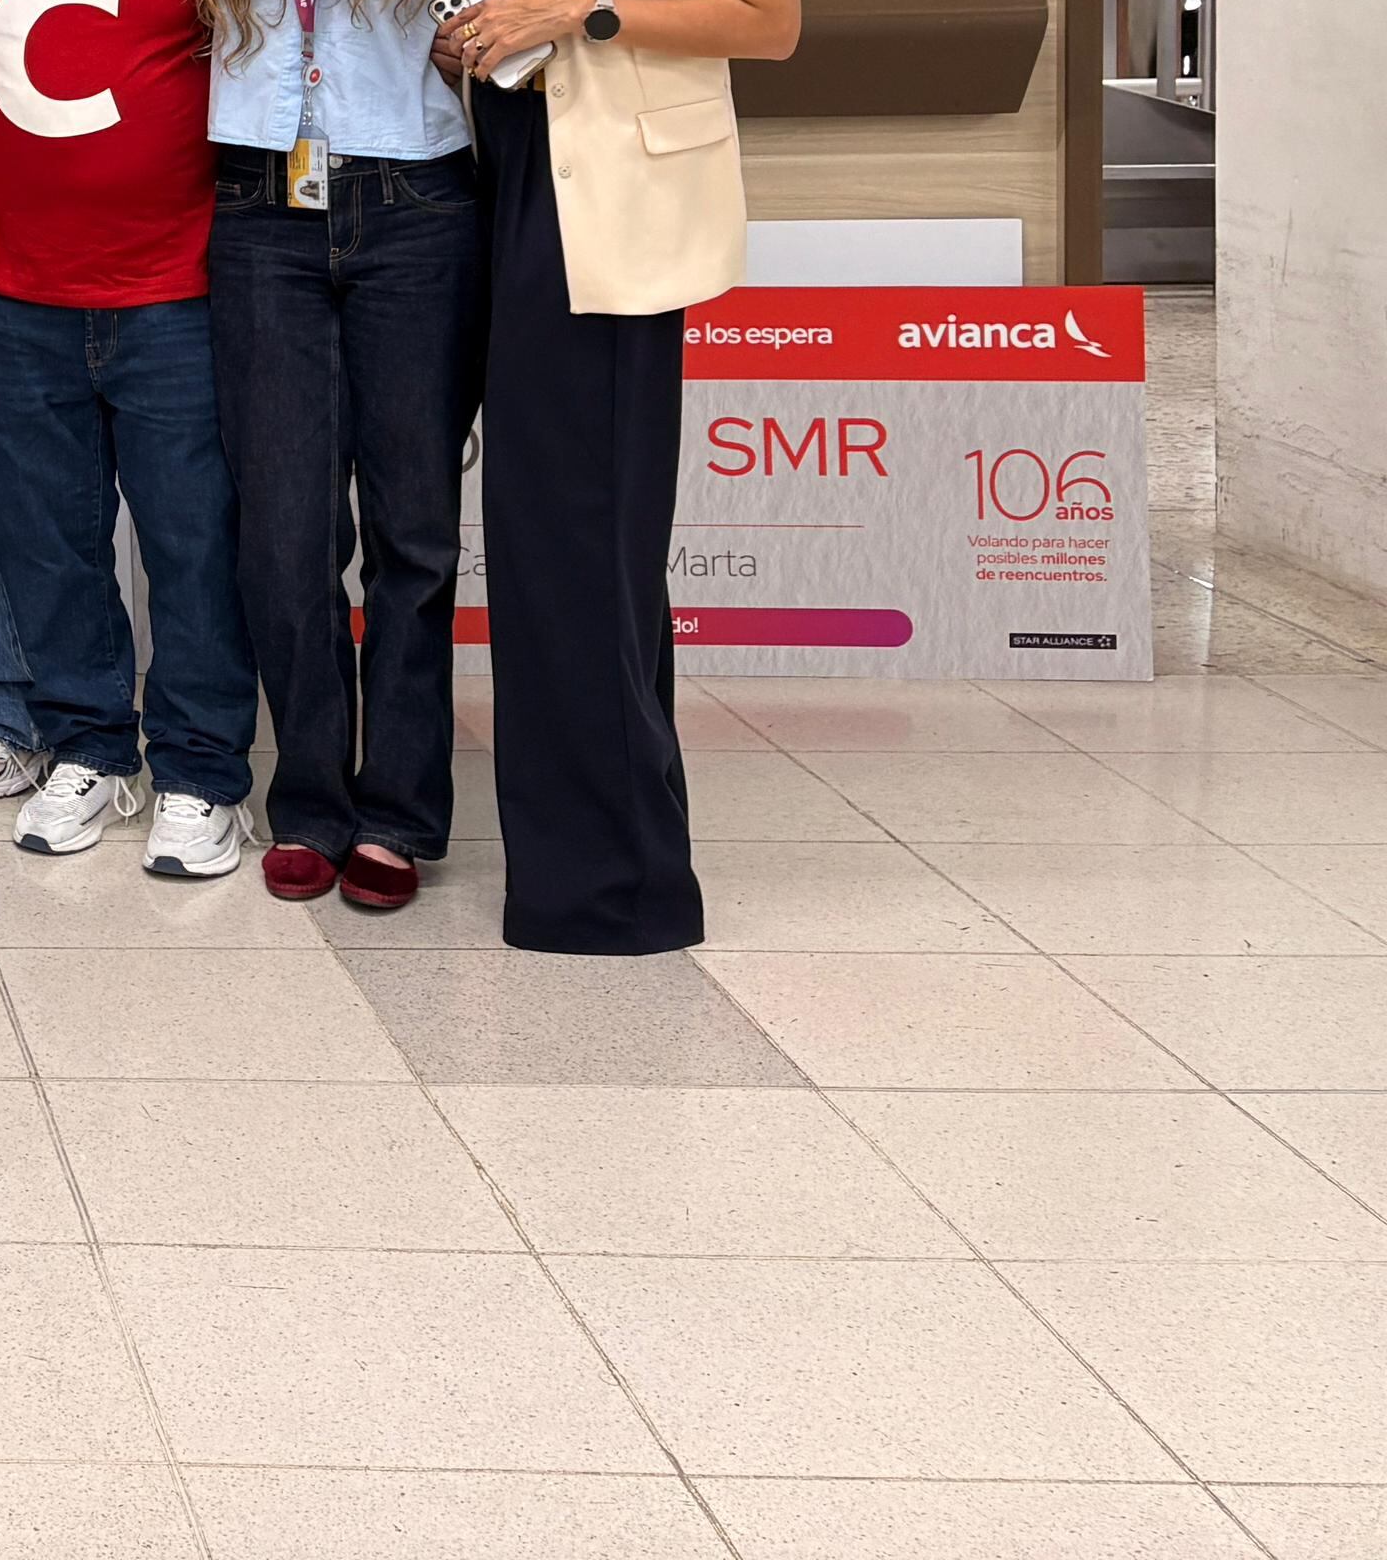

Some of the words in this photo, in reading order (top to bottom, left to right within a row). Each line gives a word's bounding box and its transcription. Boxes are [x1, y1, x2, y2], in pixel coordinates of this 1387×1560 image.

[706, 321, 742, 345] los
[745, 326, 833, 350] espera
[898, 313, 1056, 349] avianca
[707, 416, 889, 477] SMR
[964, 448, 1112, 522] 106
[1055, 501, 1115, 521] años
[967, 535, 1029, 549] Volando
[1032, 537, 1065, 551] para
[1069, 536, 1111, 549] hacer
[667, 547, 758, 578] Marta
[977, 552, 1038, 566] posibles
[1041, 552, 1106, 566] millones
[976, 568, 996, 580] de
[999, 570, 1108, 582] reencuentros.
[1013, 637, 1039, 646] STAR
[1043, 637, 1094, 646] ALLIANCE
